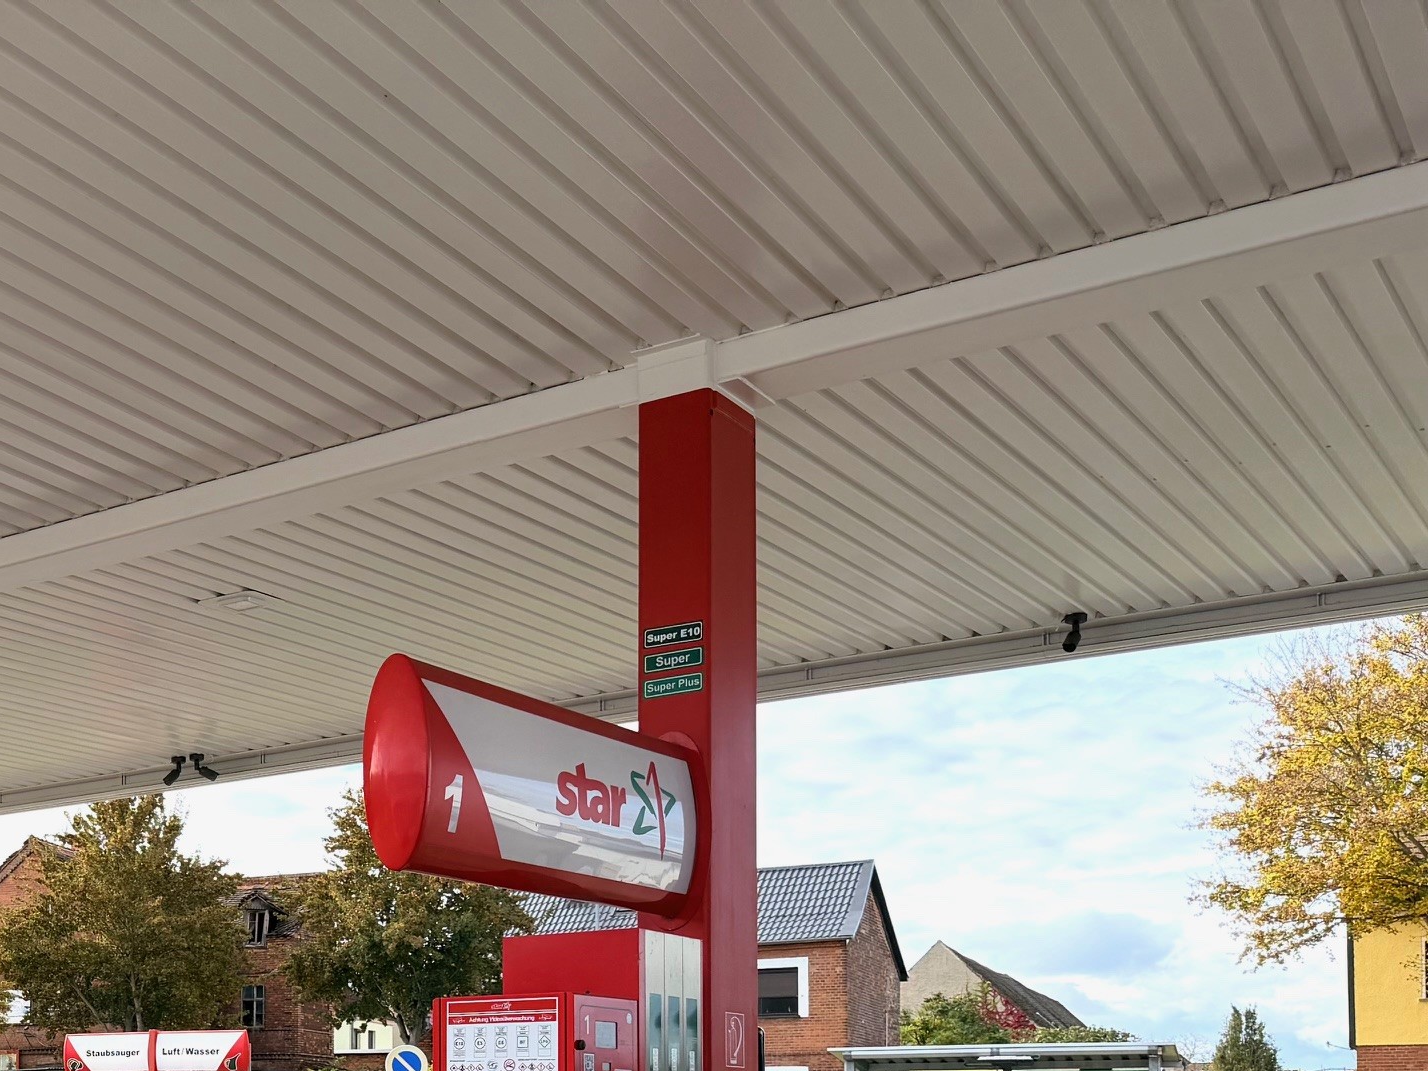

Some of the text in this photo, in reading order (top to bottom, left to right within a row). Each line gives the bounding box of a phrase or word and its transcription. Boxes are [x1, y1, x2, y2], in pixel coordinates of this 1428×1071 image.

[646, 626, 700, 643] Super E10
[655, 653, 691, 667] Super
[646, 678, 700, 693] Super Plus
[444, 774, 464, 833] 1
[555, 762, 627, 828] star
[584, 1014, 590, 1035] 1
[86, 1049, 140, 1058] Staubsauger
